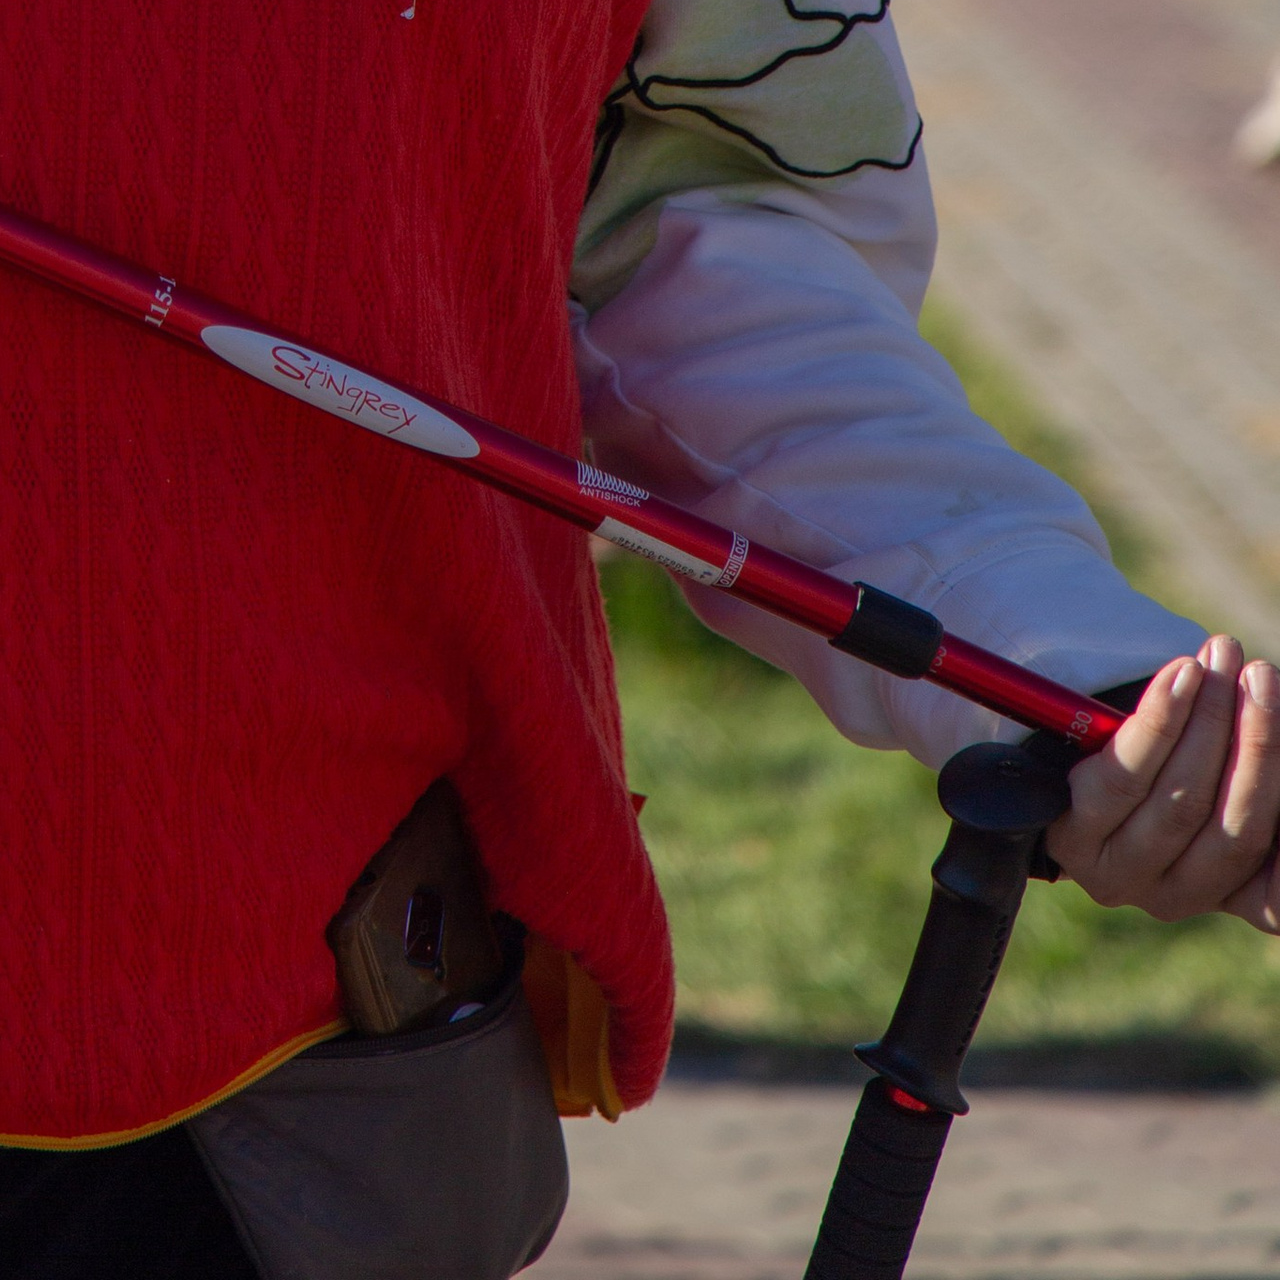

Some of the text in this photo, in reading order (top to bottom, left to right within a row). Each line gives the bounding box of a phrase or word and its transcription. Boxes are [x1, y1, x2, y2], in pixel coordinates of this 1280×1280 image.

[579, 486, 641, 508] ANTISHOCK
[719, 560, 739, 586] OPEN
[1069, 710, 1093, 744] 130
